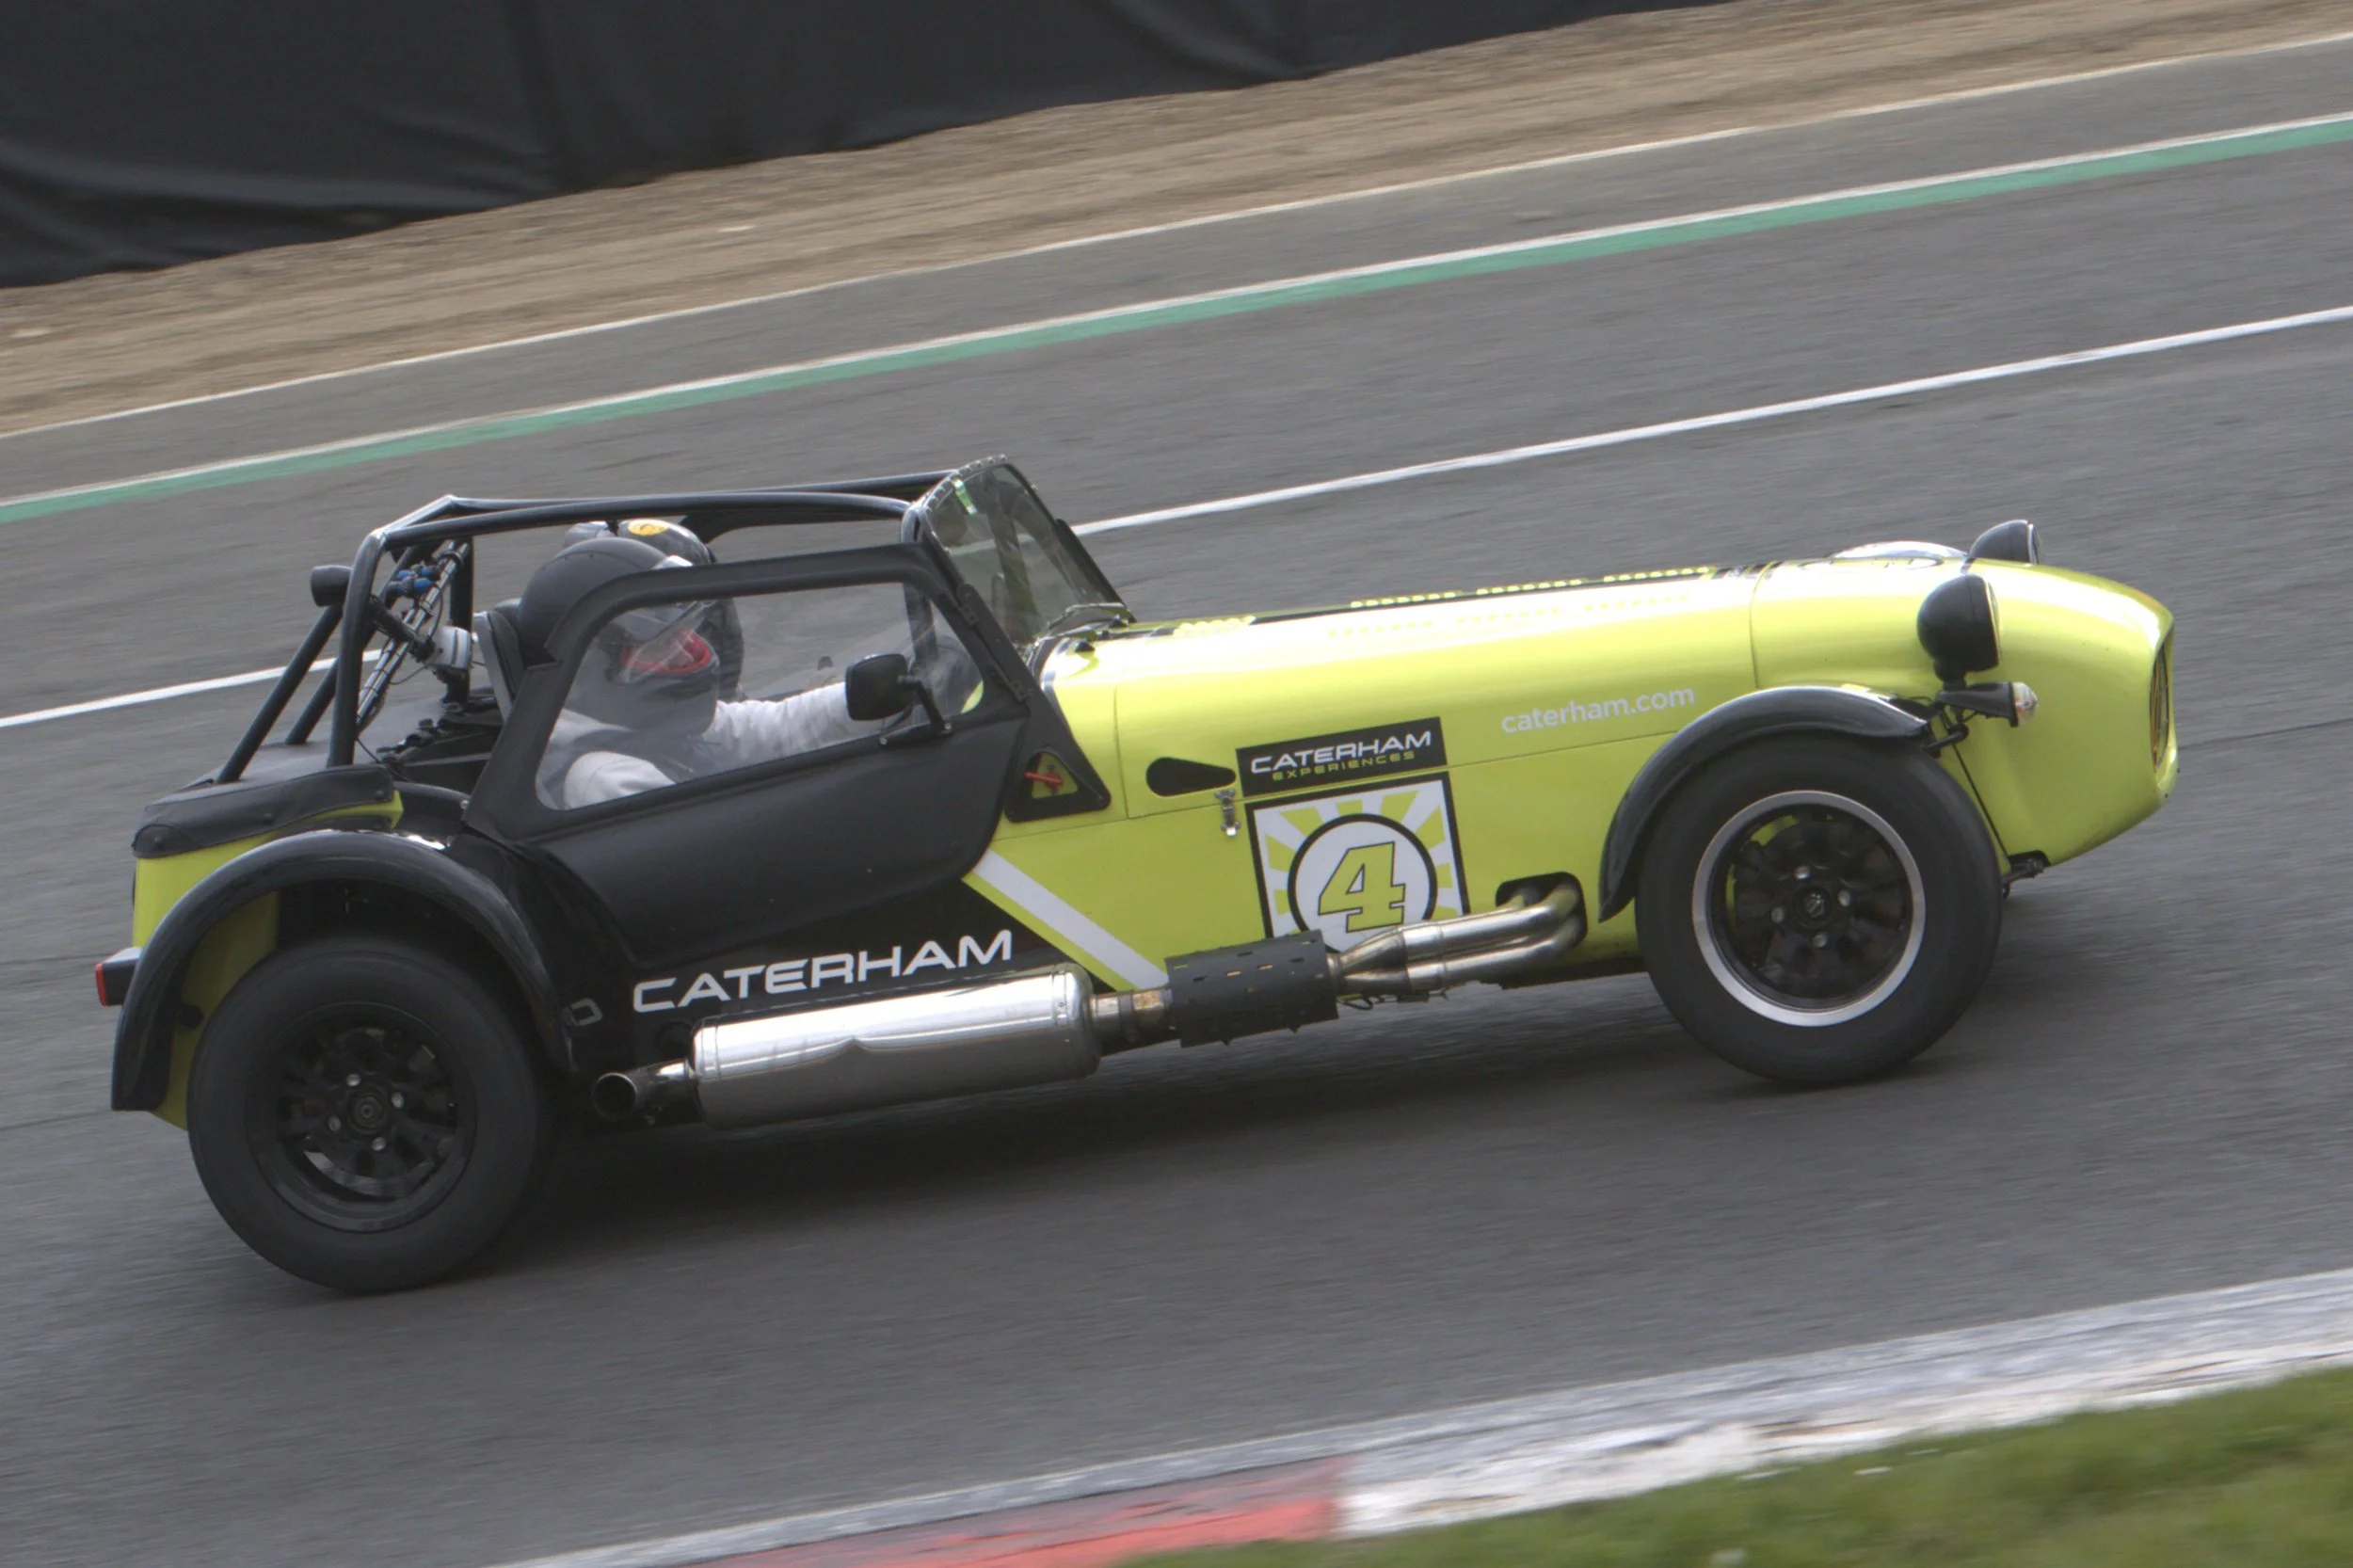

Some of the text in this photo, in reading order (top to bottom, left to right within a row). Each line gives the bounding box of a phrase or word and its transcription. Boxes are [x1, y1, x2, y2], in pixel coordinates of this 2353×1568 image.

[1501, 687, 1695, 733] caterham.com
[1251, 730, 1432, 774] CATERHAM
[1273, 750, 1416, 781] EXPERIENCES
[1319, 840, 1406, 934] 4
[633, 929, 1013, 1014] CATERHAM
